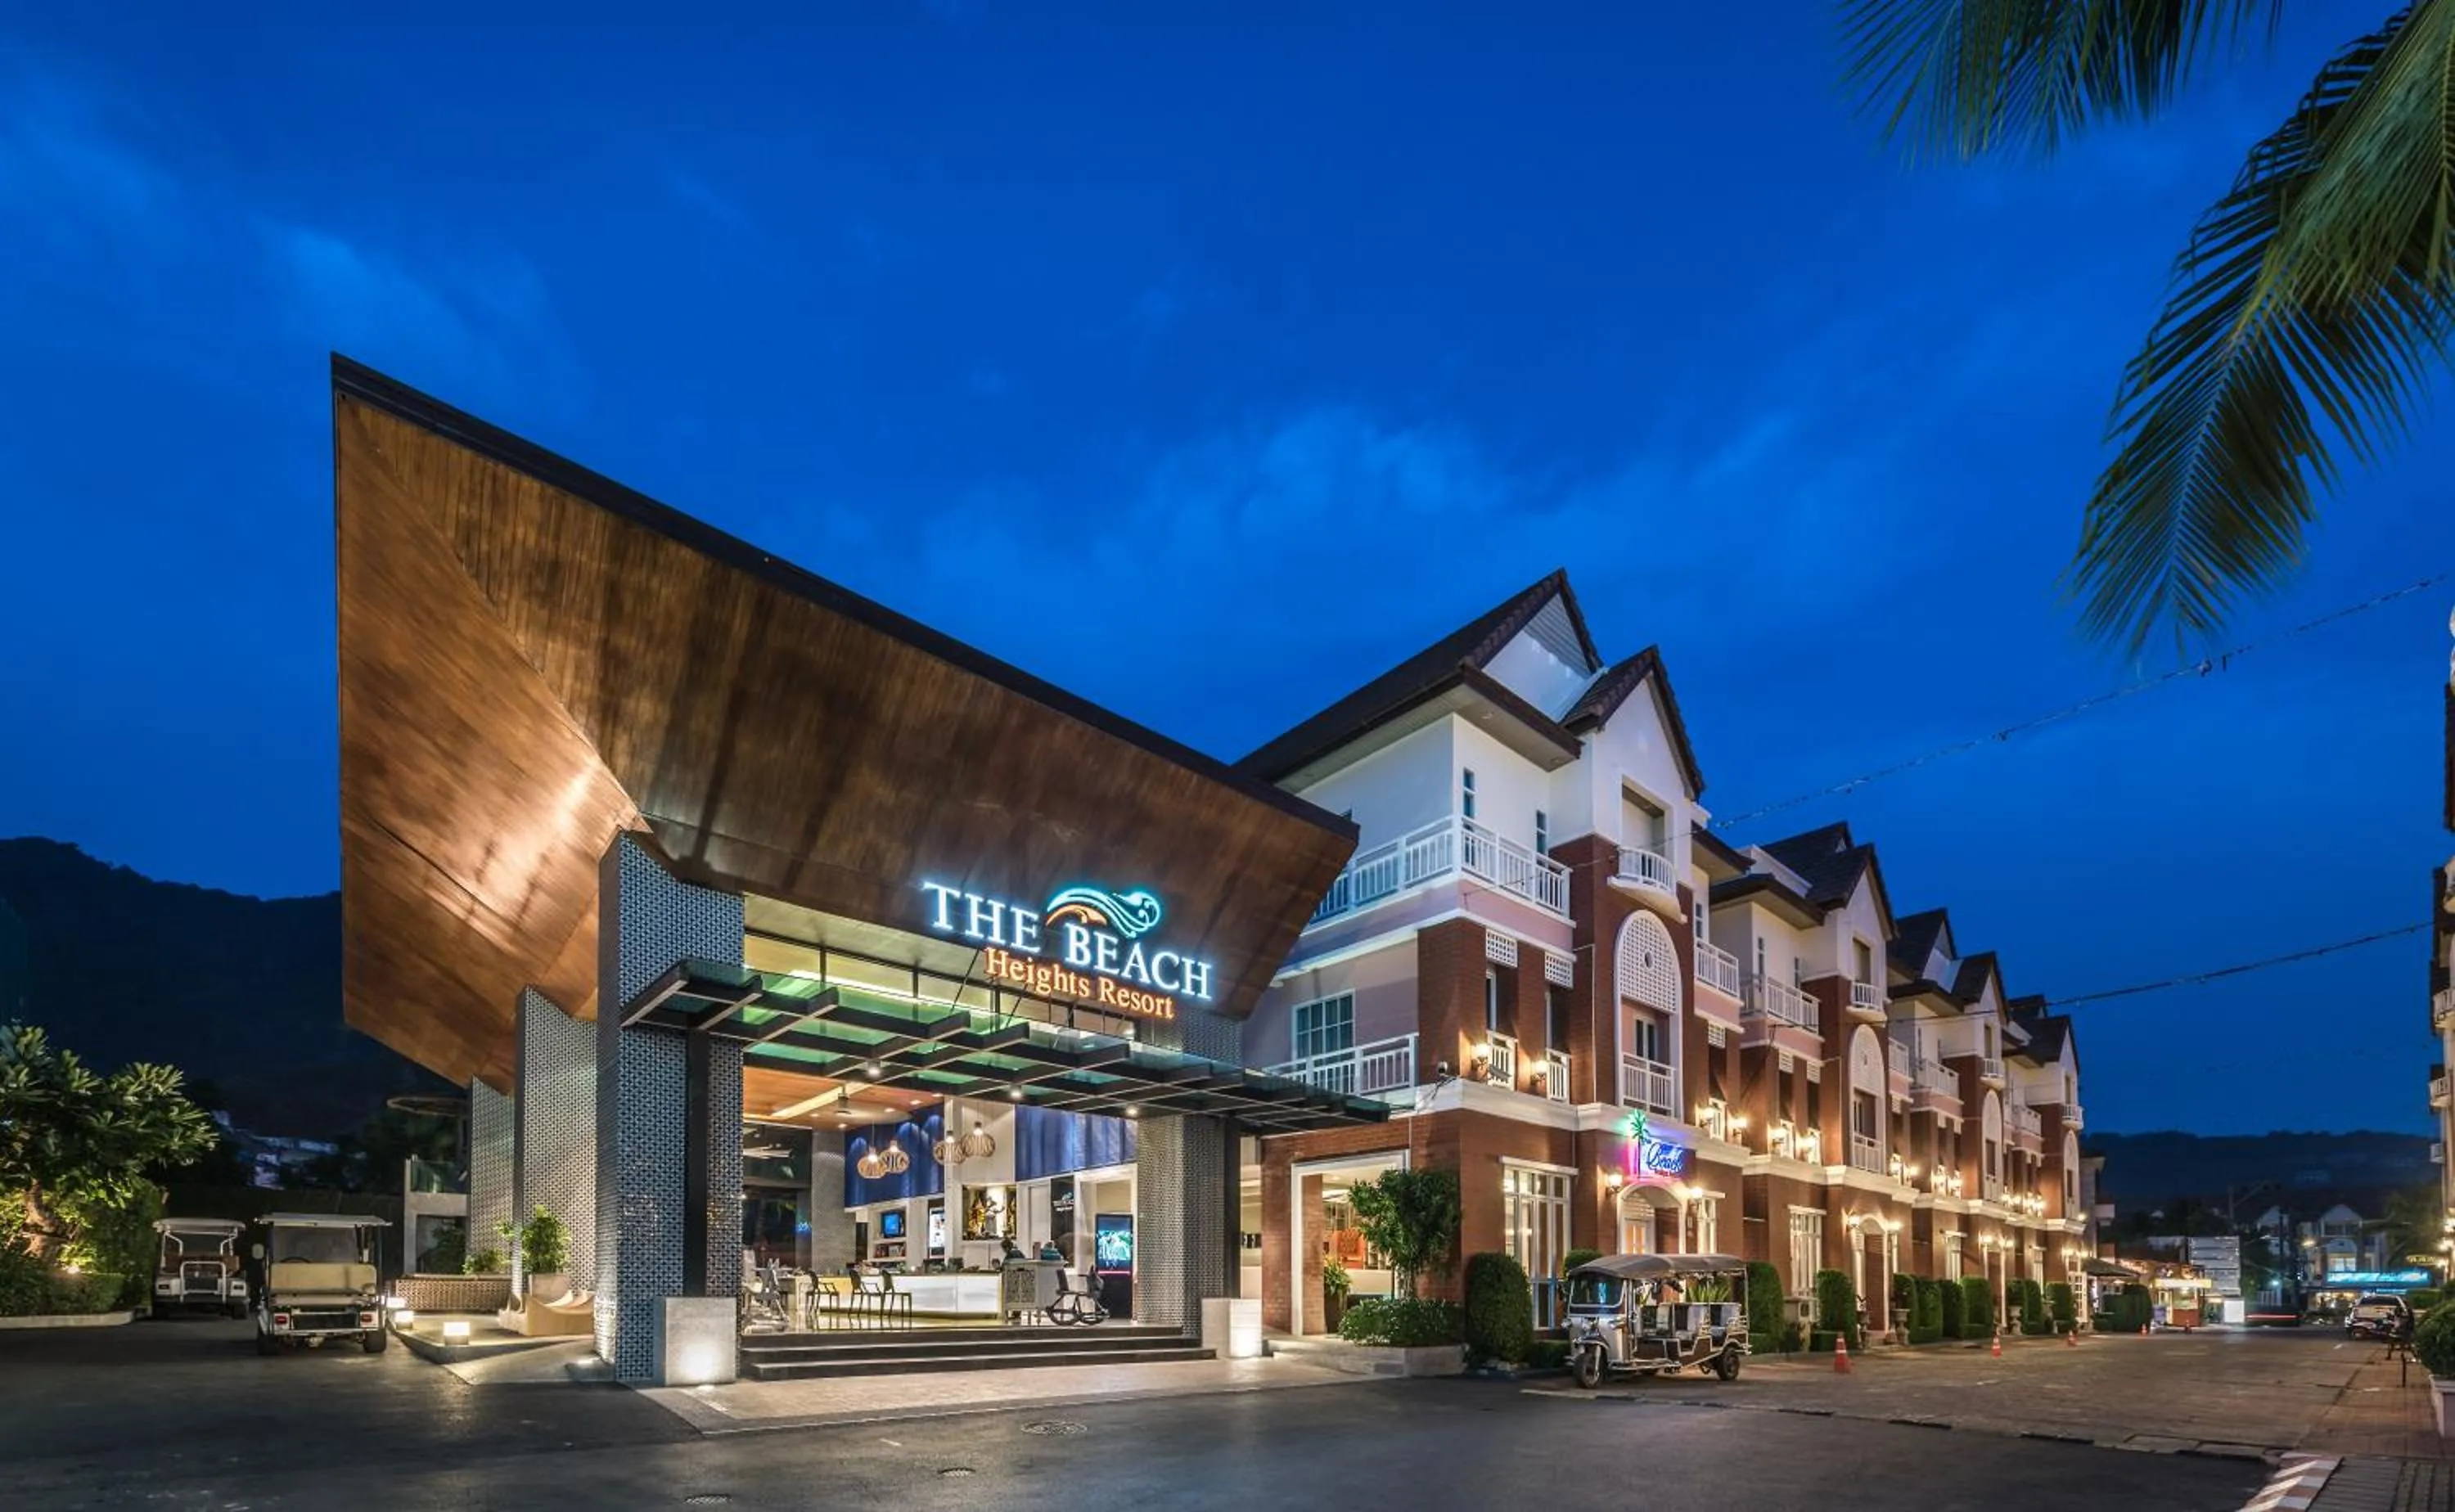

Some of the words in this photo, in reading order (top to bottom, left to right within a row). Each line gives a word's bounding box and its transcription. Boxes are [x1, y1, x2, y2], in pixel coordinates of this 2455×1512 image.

[923, 881, 1041, 953] THE
[1065, 923, 1211, 999] BEACH
[984, 947, 1090, 997] Heights
[1100, 977, 1175, 1019] Resort
